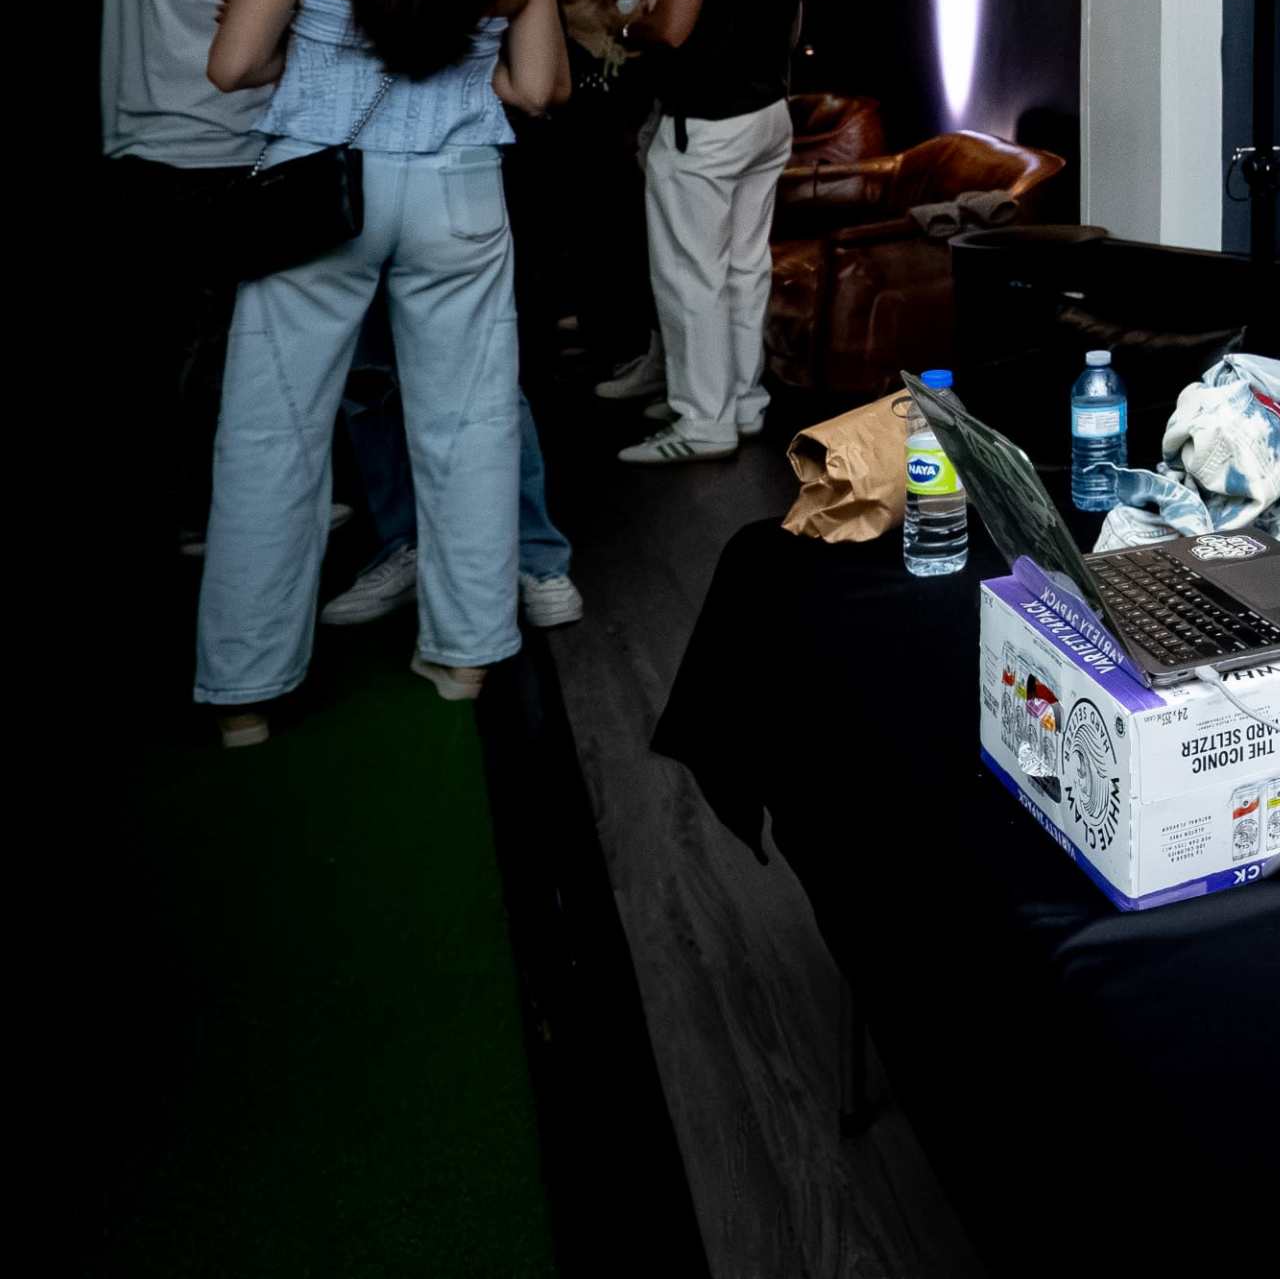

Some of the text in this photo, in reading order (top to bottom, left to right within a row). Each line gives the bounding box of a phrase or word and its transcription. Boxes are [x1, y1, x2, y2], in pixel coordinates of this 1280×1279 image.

[908, 461, 936, 476] NAYA
[1057, 633, 1117, 674] VARIETY
[1090, 711, 1110, 753] HARD
[1181, 728, 1241, 757] SELTZER
[1192, 738, 1275, 774] THE ICONIC
[1064, 778, 1120, 851] WHITE CLAW
